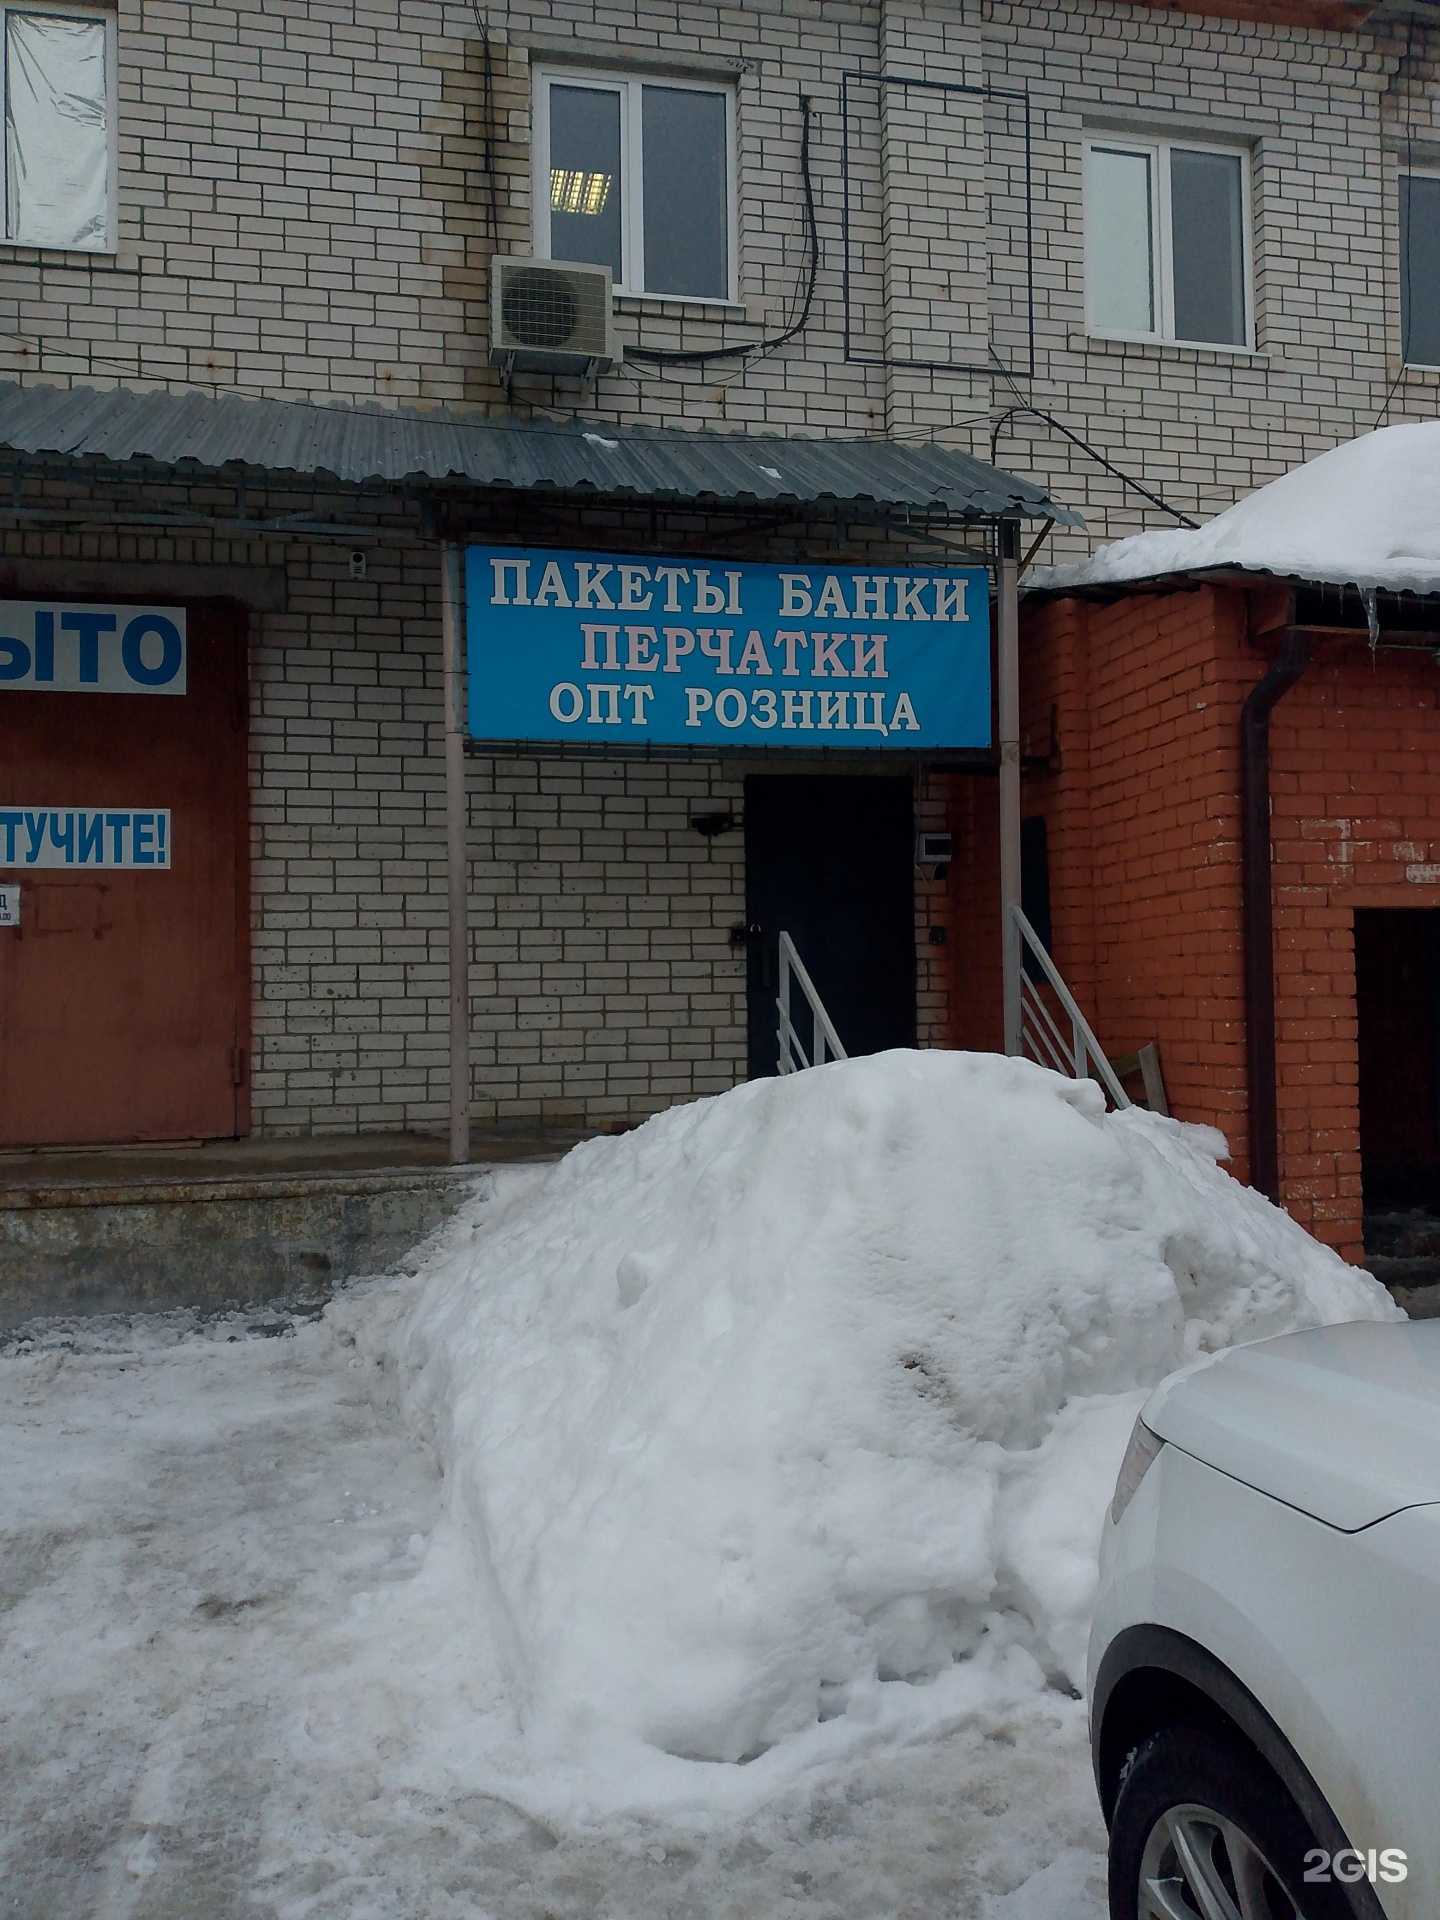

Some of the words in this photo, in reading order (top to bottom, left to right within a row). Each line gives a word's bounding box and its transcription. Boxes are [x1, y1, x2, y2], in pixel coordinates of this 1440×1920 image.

[489, 558, 744, 615] ПАКЕТЫ
[778, 573, 971, 622] БАНКИ
[579, 623, 890, 678] ПЕРЧАТКИ
[549, 682, 655, 725] ОПТ
[684, 687, 922, 737] РОЗНИЦА
[0, 811, 167, 865] ТУЧИТЕ!
